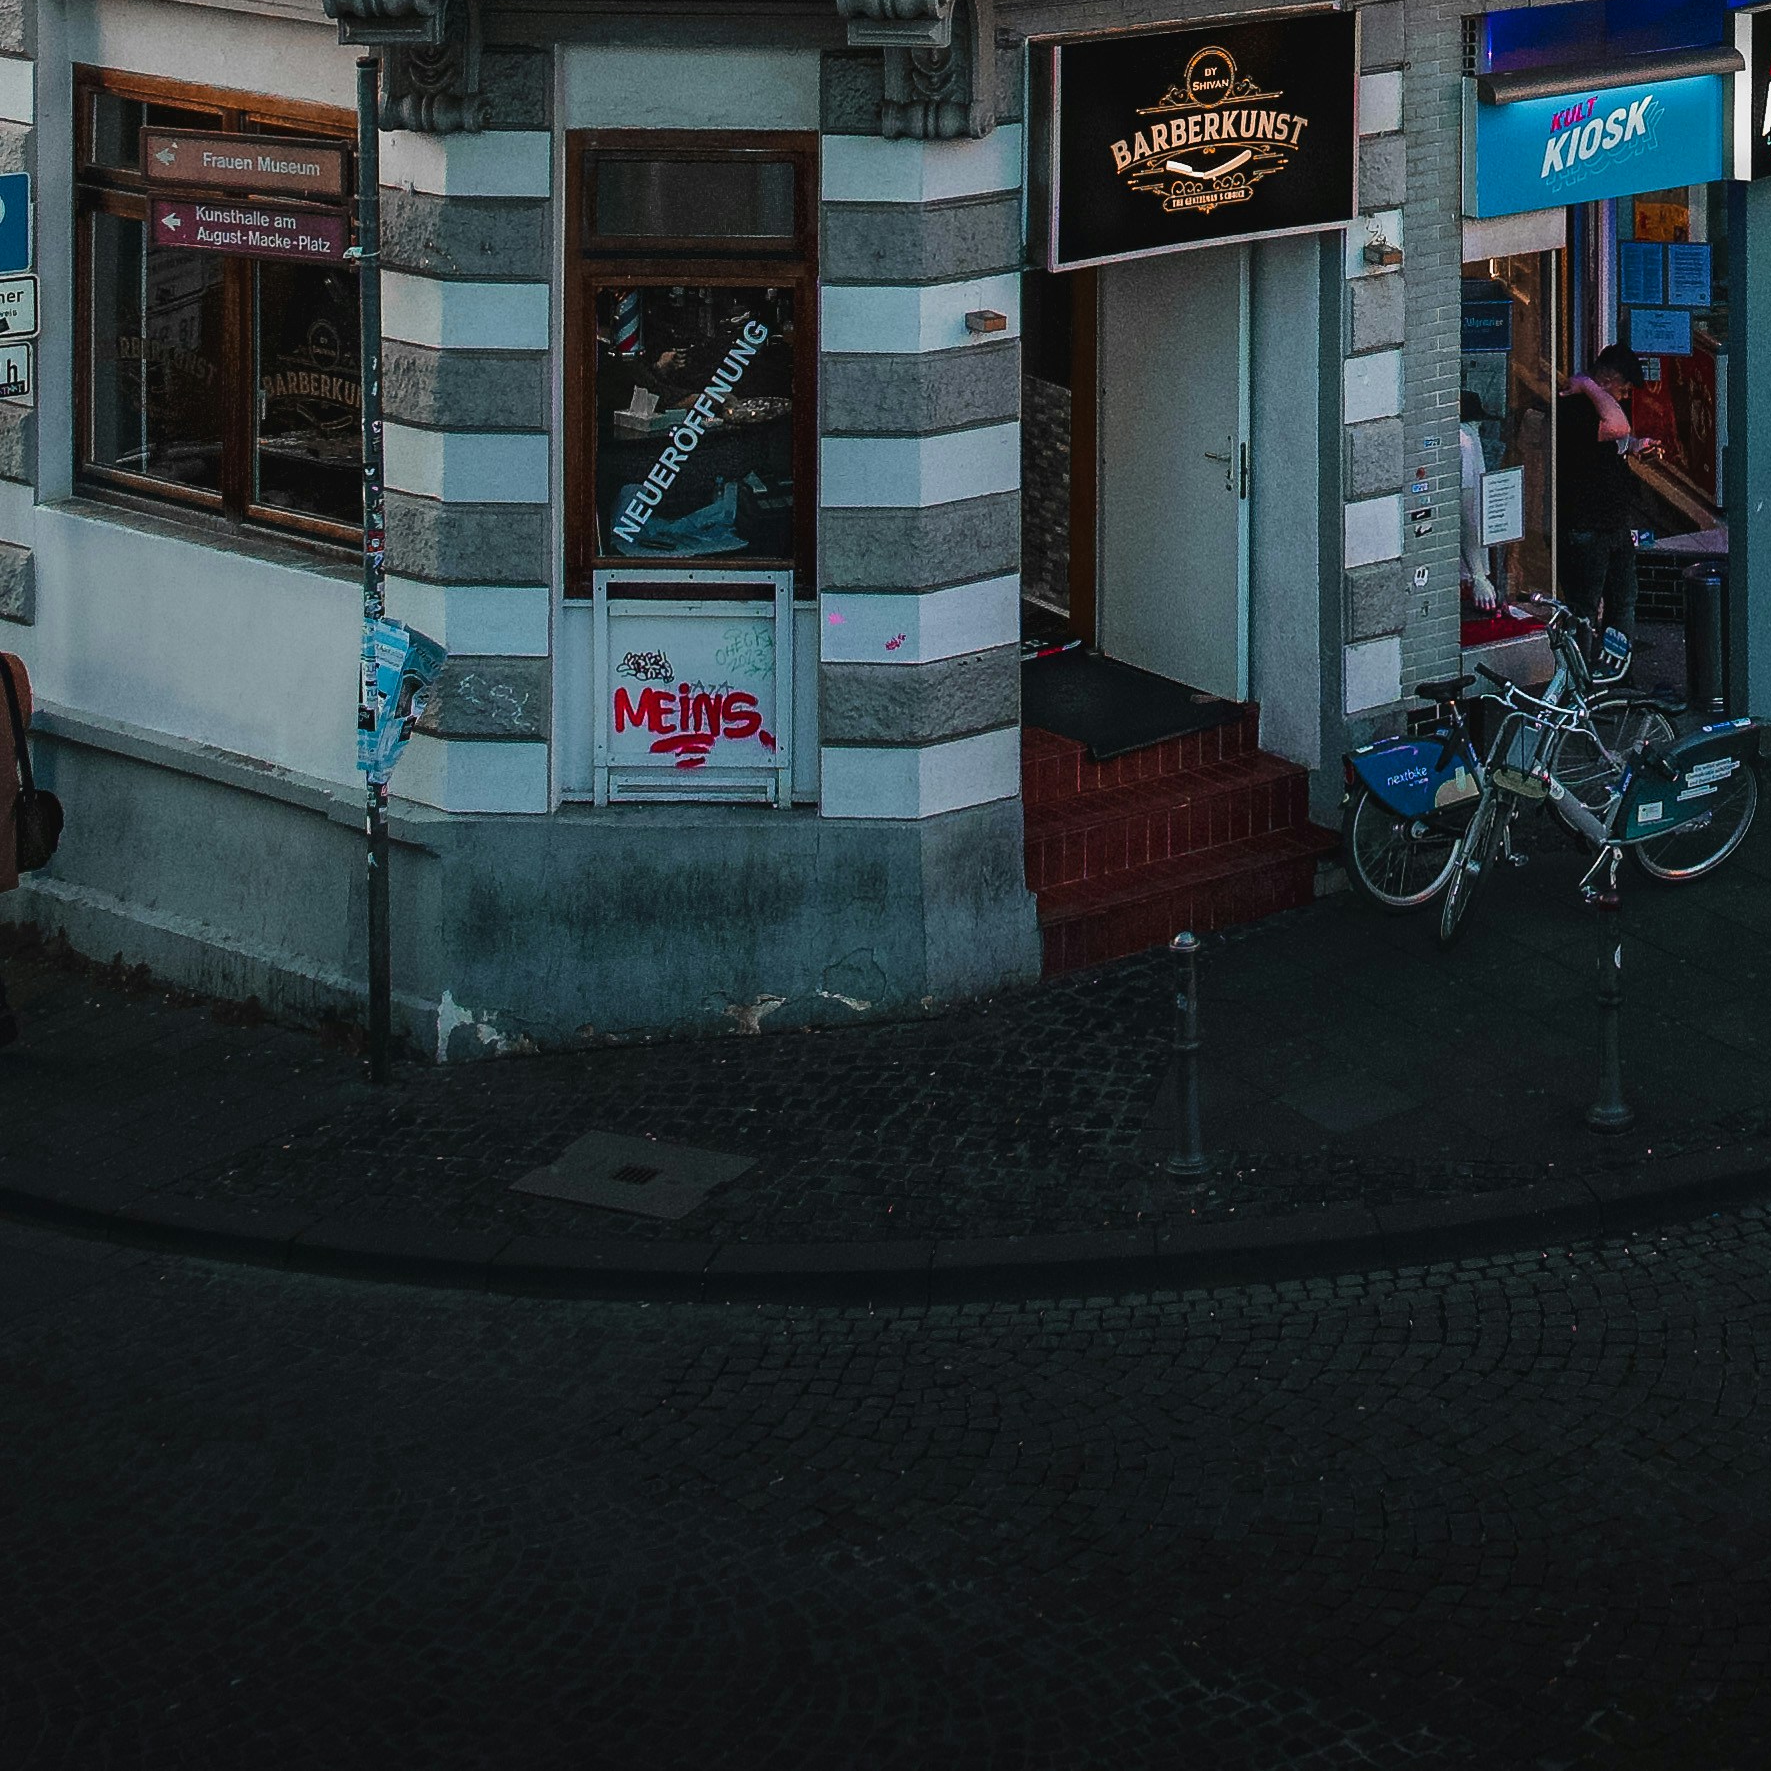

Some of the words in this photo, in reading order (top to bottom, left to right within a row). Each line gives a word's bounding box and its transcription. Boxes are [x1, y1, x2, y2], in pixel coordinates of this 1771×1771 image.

[1192, 79, 1229, 92] SHIVAN
[1550, 96, 1598, 134] KULT
[1110, 110, 1308, 170] BARBERKUNST
[1540, 94, 1654, 179] KIOSK
[203, 152, 253, 171] Frauen
[257, 156, 320, 176] Museum
[196, 206, 270, 227] Kunsthalle
[274, 216, 297, 230] am
[197, 227, 331, 253] August-Macke-Platz
[612, 320, 768, 543] NEUERÖFFNUNG
[1387, 766, 1428, 786] nextbike
